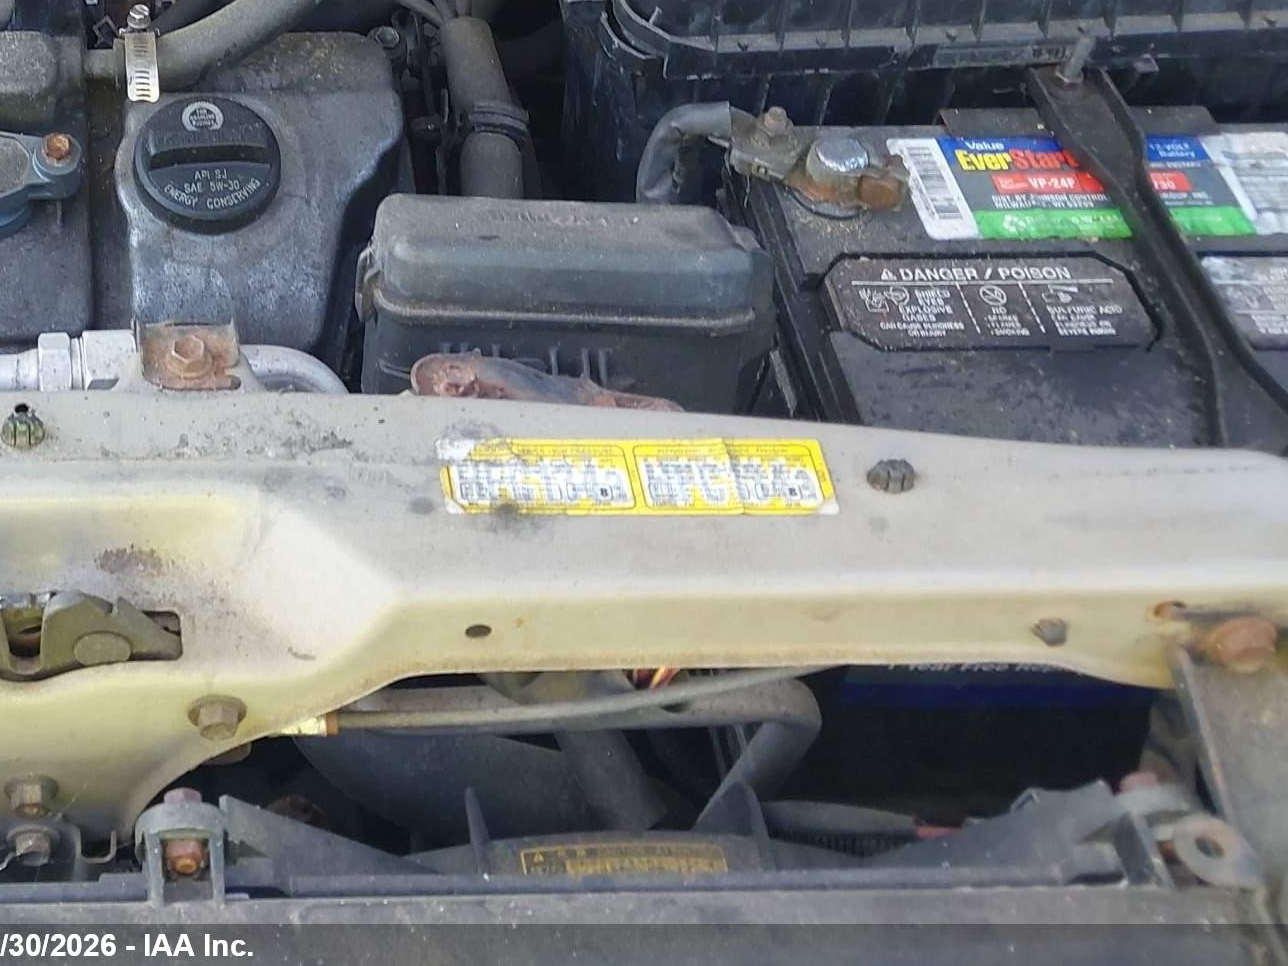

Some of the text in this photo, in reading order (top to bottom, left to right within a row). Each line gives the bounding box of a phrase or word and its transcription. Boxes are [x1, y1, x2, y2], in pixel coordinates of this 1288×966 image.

[963, 140, 1005, 151] Value
[955, 149, 1079, 171] EverStart
[194, 169, 211, 181] API
[164, 177, 262, 210] ENERGY CONSERVING
[183, 179, 241, 194] SAE 5W-30
[899, 265, 1072, 281] DANGER / POISON
[898, 305, 954, 315] EXPLOSIVE
